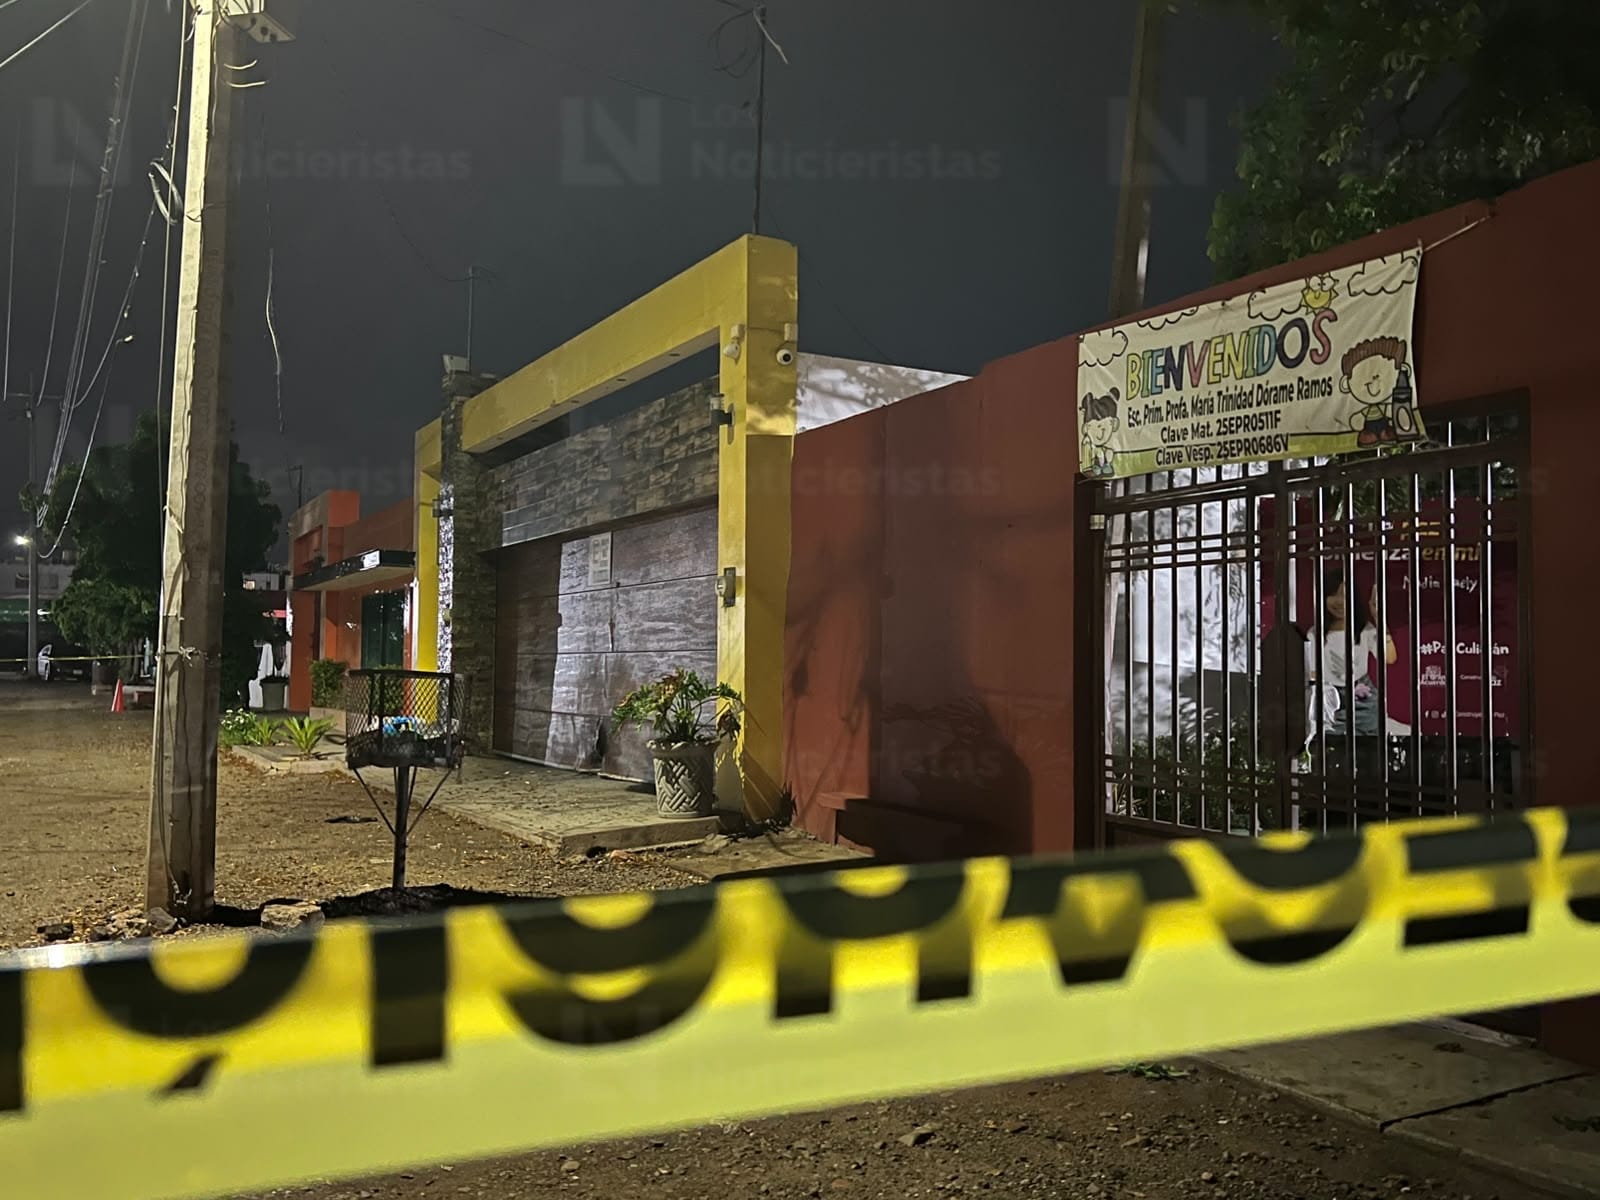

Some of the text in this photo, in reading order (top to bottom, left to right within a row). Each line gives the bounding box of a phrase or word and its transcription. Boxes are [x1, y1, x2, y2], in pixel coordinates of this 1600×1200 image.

[1126, 308, 1338, 400] BIENVENIDOS
[1128, 376, 1333, 428] Esc. Prim. Profa. María Trinidad Dórame Ramos
[1160, 410, 1281, 444] Clave Mat. 25EPR0511F
[1156, 434, 1290, 466] Clave Vesp. 25EPR0686V
